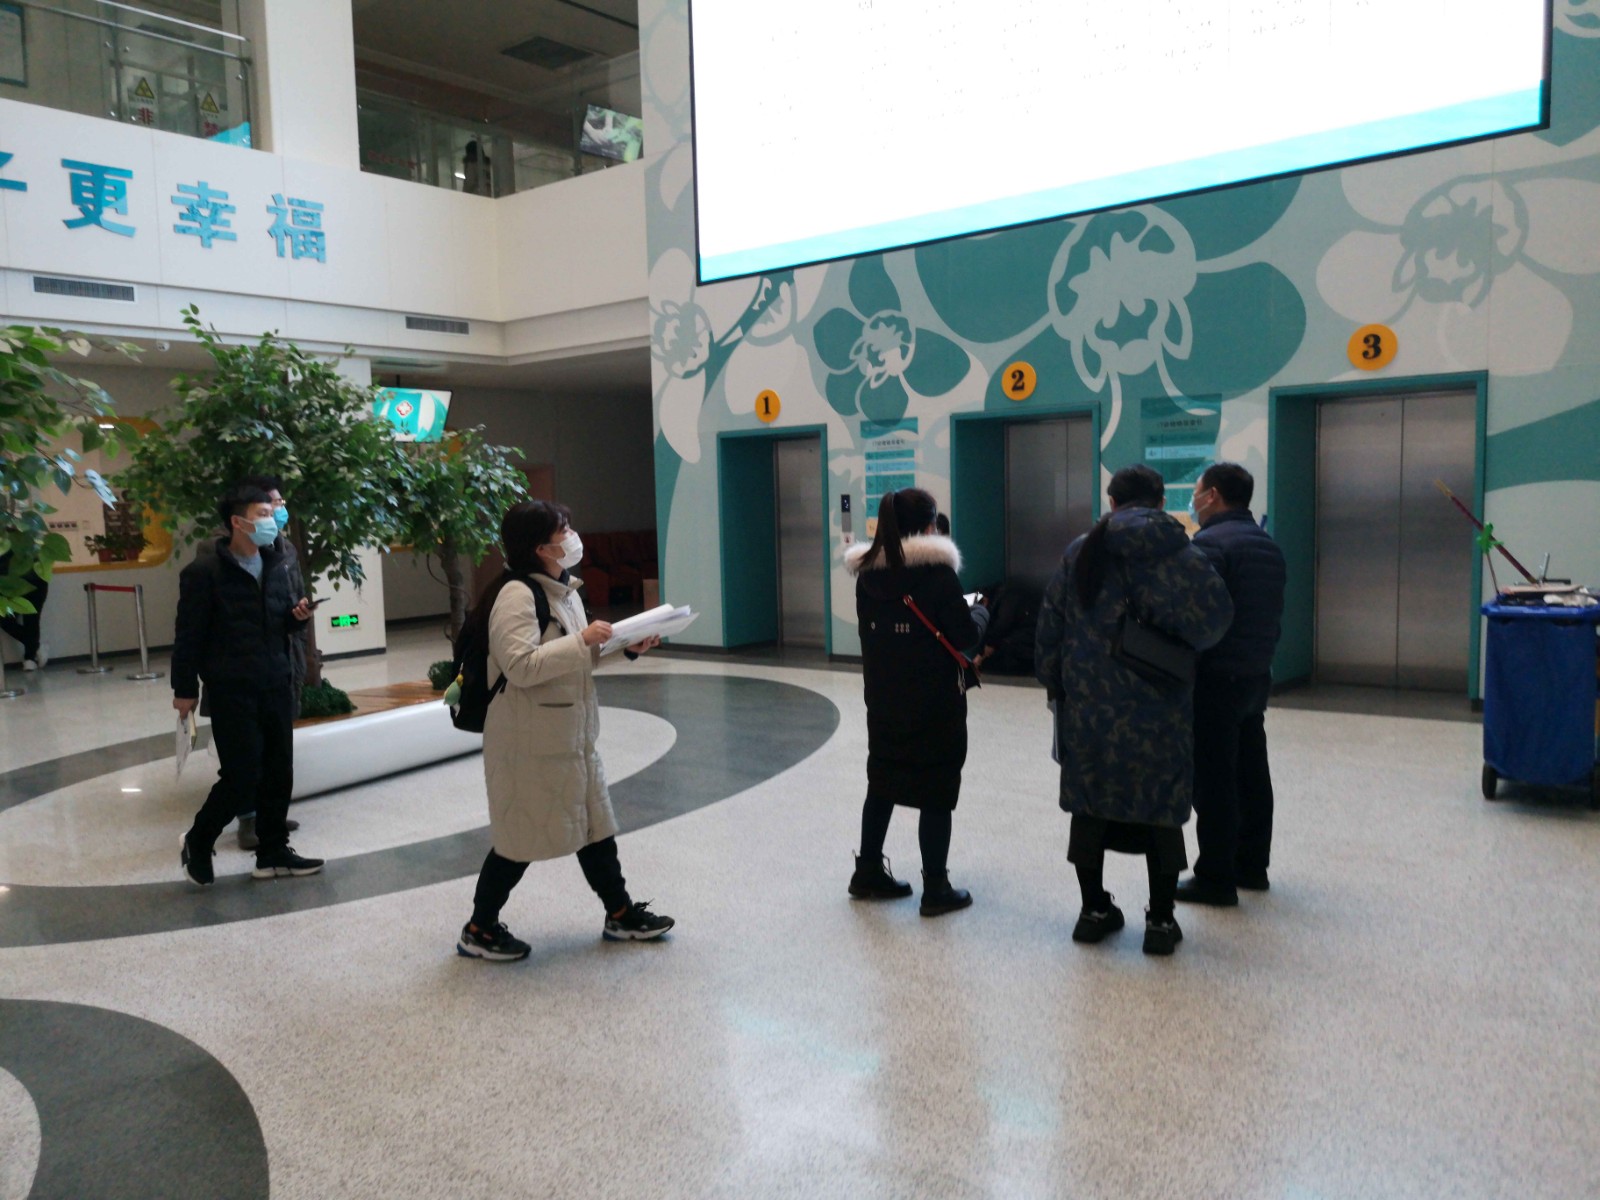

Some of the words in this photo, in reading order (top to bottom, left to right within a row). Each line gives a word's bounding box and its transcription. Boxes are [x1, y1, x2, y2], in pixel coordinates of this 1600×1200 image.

[1362, 333, 1382, 360] 3
[1011, 369, 1025, 392] 2
[762, 395, 772, 415] 1
